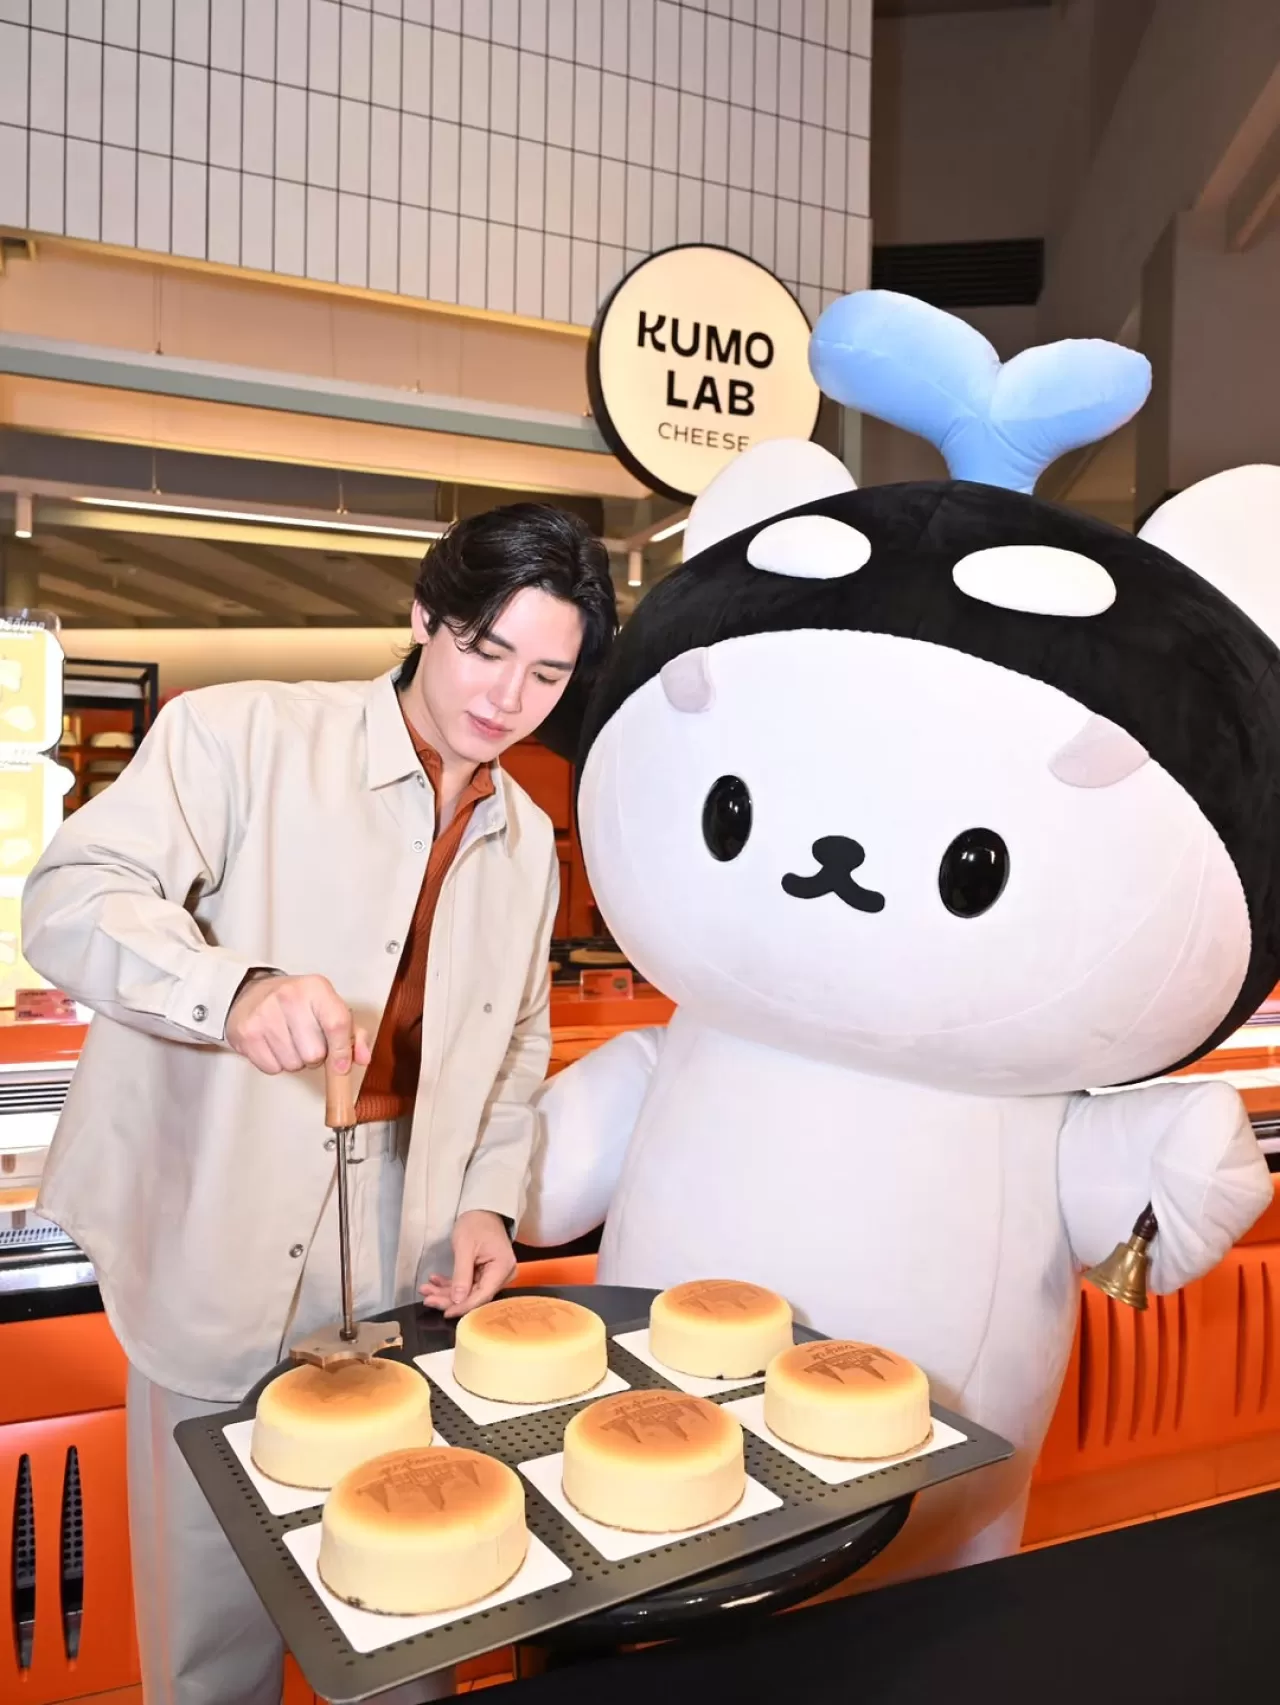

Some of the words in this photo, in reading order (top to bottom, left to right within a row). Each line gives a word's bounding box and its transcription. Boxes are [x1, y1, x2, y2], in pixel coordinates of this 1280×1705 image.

[637, 310, 775, 370] KUMO
[666, 369, 756, 417] LAB
[657, 421, 750, 453] CHEESE
